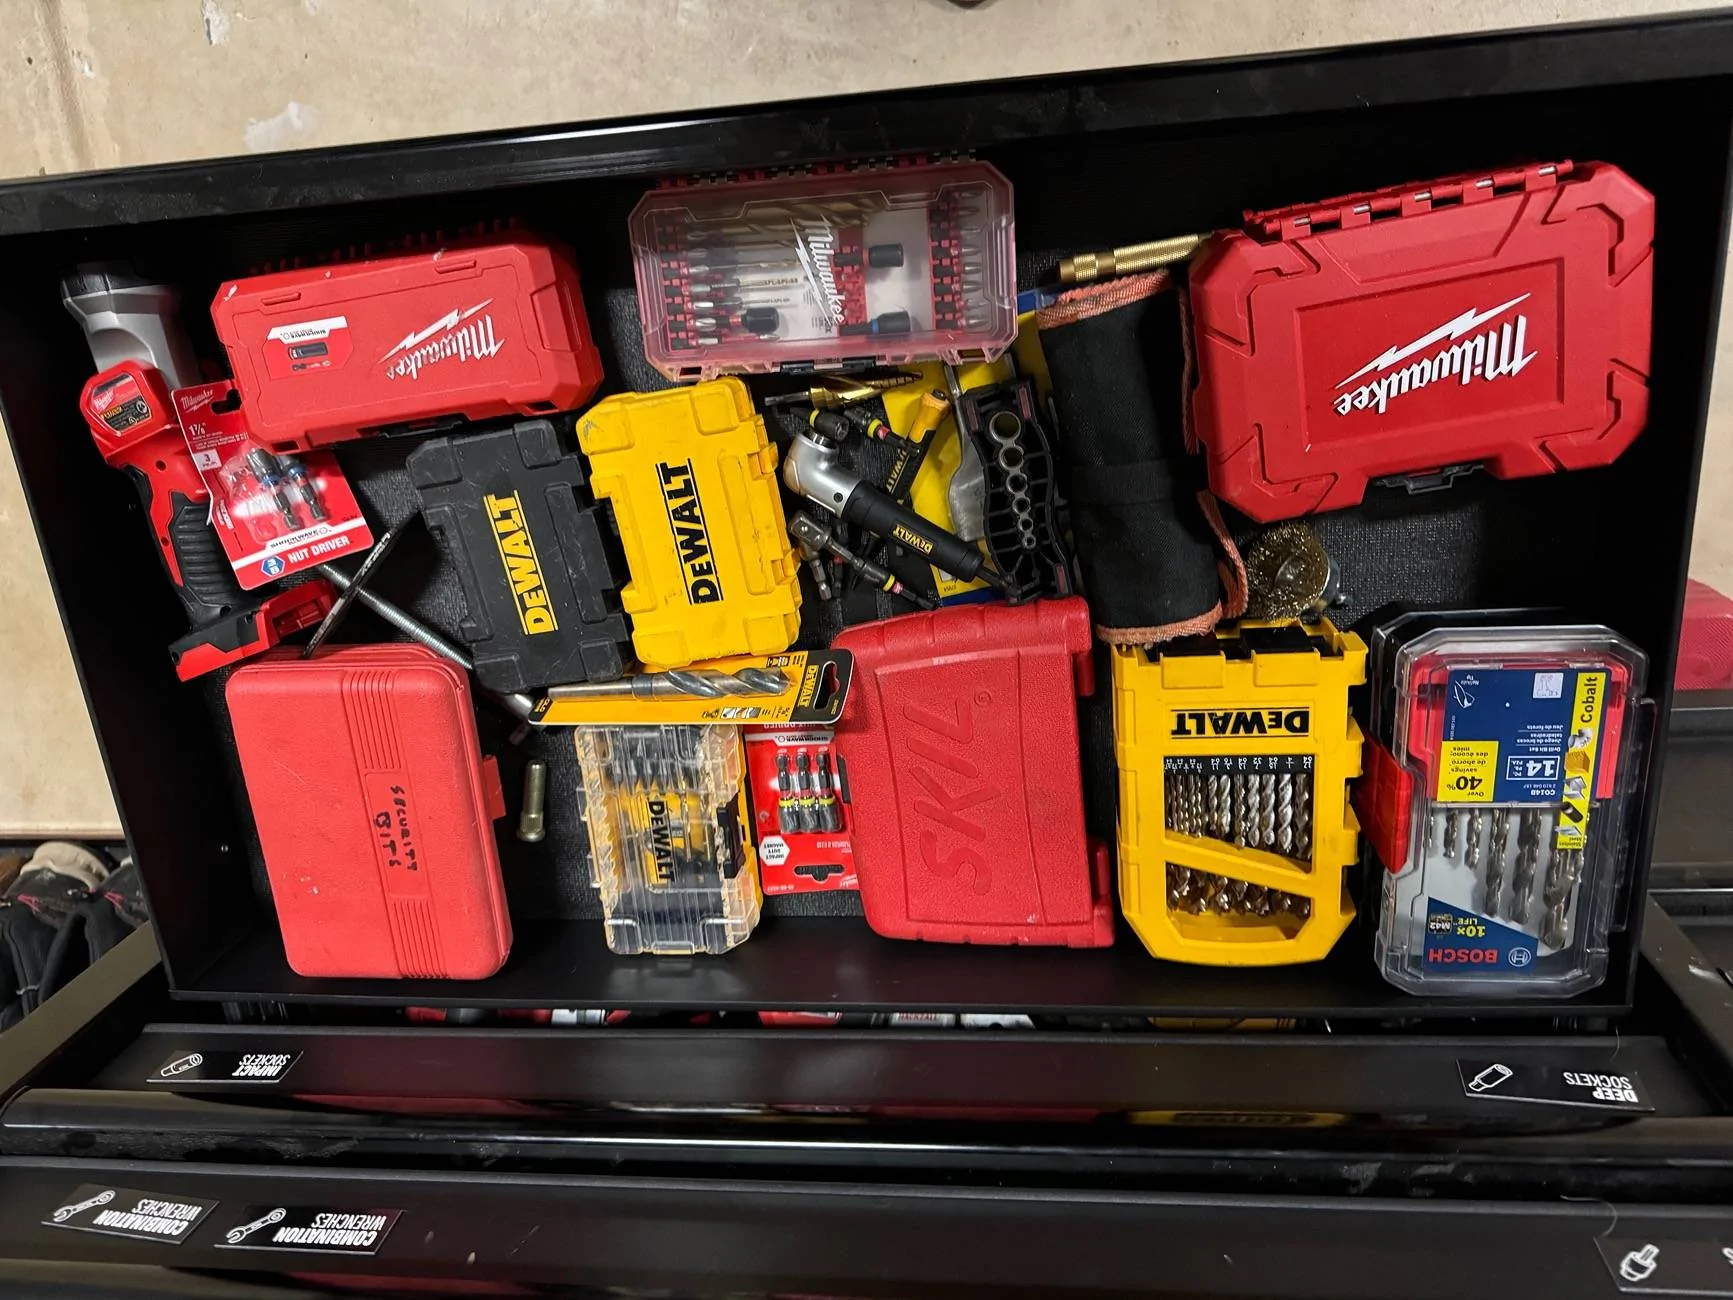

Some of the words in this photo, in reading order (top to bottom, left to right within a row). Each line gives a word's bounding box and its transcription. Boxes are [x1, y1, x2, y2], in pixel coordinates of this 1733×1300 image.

[805, 213, 848, 326] Milwaukee
[386, 314, 505, 381] Milwaukee
[1333, 314, 1538, 416] Milwaukee
[203, 453, 210, 464] 3
[665, 460, 722, 605] DEWALT
[893, 524, 934, 555] DEWALT
[288, 549, 310, 564] NUT
[311, 535, 350, 557] DRIVER
[487, 493, 556, 634] DEWALT
[798, 664, 819, 707] DEWALT
[1581, 676, 1598, 723] Cobalt
[1171, 709, 1310, 737] DEWALT
[1526, 760, 1555, 777] 14
[1446, 775, 1483, 790] 40%
[903, 701, 1001, 896] SKIL
[647, 799, 676, 883] DEWALT
[1430, 922, 1450, 930] M42
[1428, 948, 1498, 964] BOSCH
[232, 1064, 282, 1077] IMPACT
[239, 1054, 291, 1066] SOCKETS
[1563, 1071, 1633, 1090] SOCKETS
[1592, 1087, 1639, 1103] DEEP
[92, 1209, 190, 1236] COMBINATION
[131, 1198, 203, 1222] WRENCHES
[311, 1212, 387, 1231] WRENCHES
[272, 1226, 378, 1247] COMBINATION
